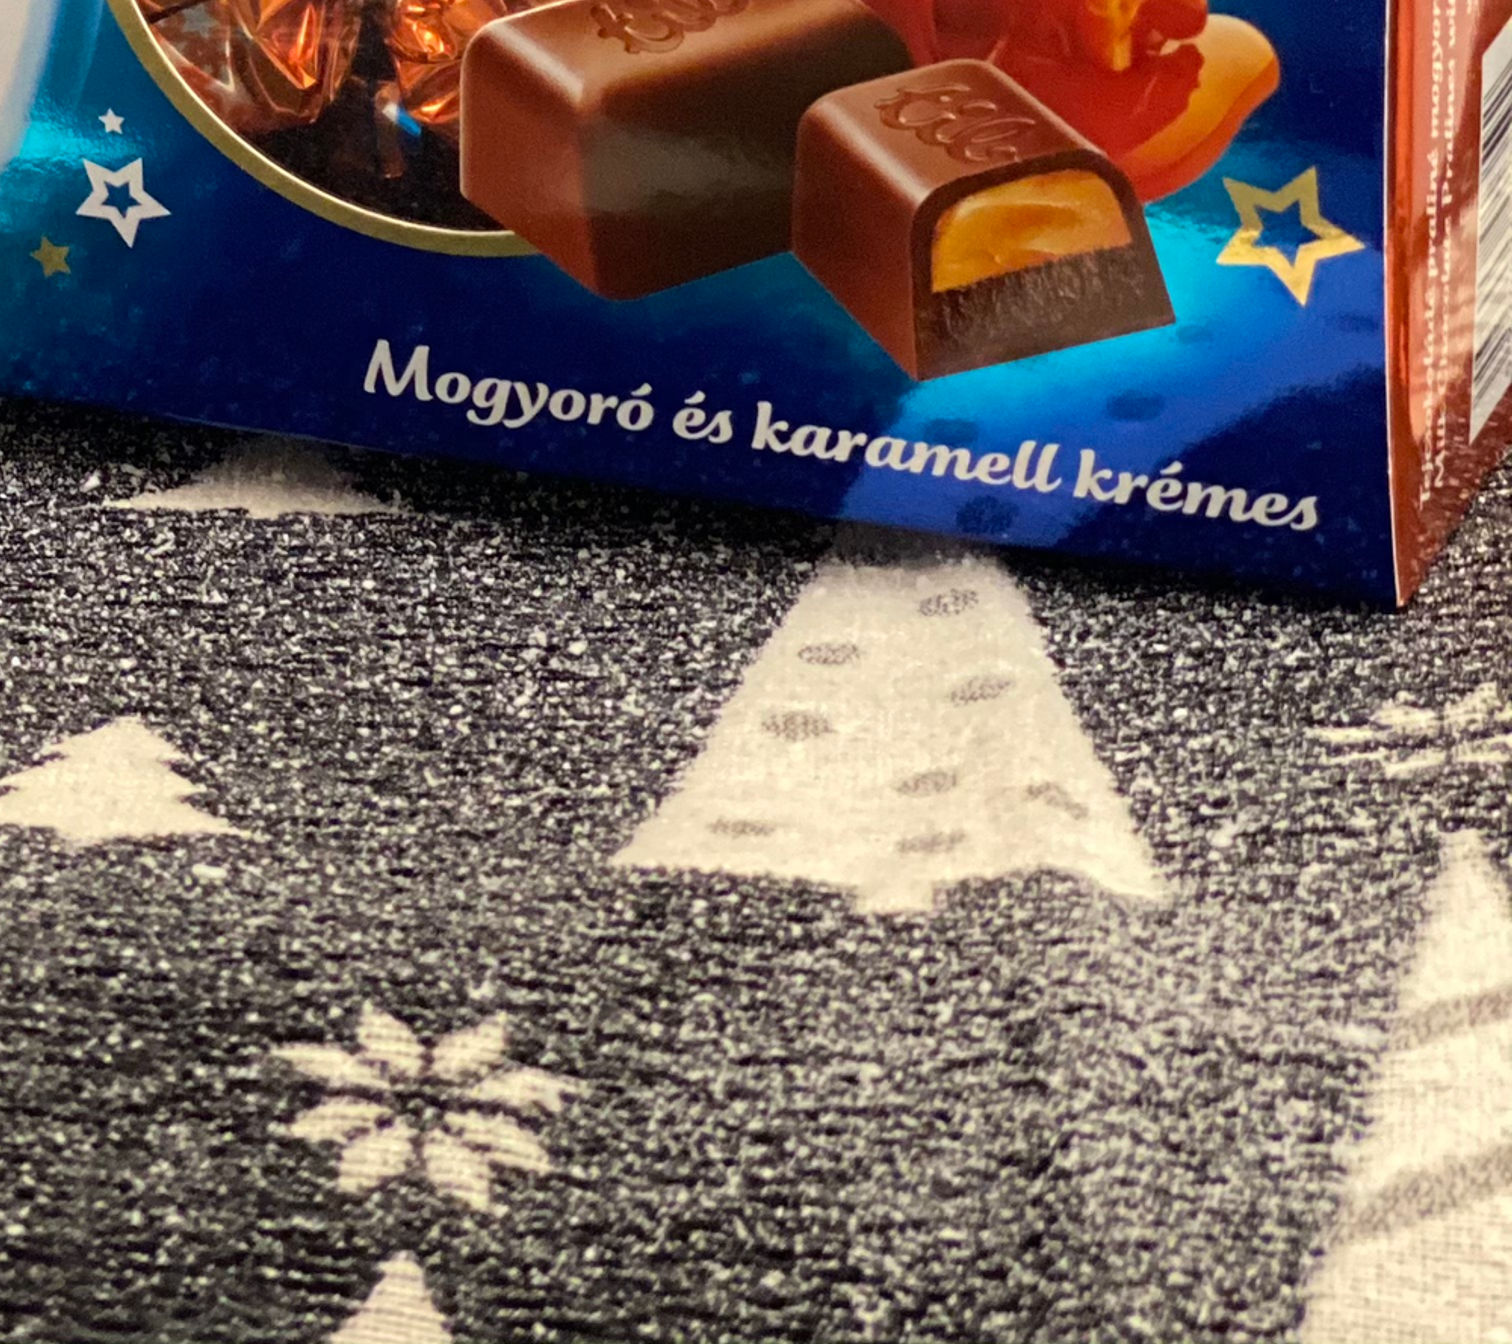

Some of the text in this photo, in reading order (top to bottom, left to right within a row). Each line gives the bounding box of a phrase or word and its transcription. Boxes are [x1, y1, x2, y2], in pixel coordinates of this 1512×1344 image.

[1441, 59, 1455, 207] Pralines
[1425, 150, 1439, 278] praliné
[363, 338, 1320, 531] Mogyoró és karamell krémes
